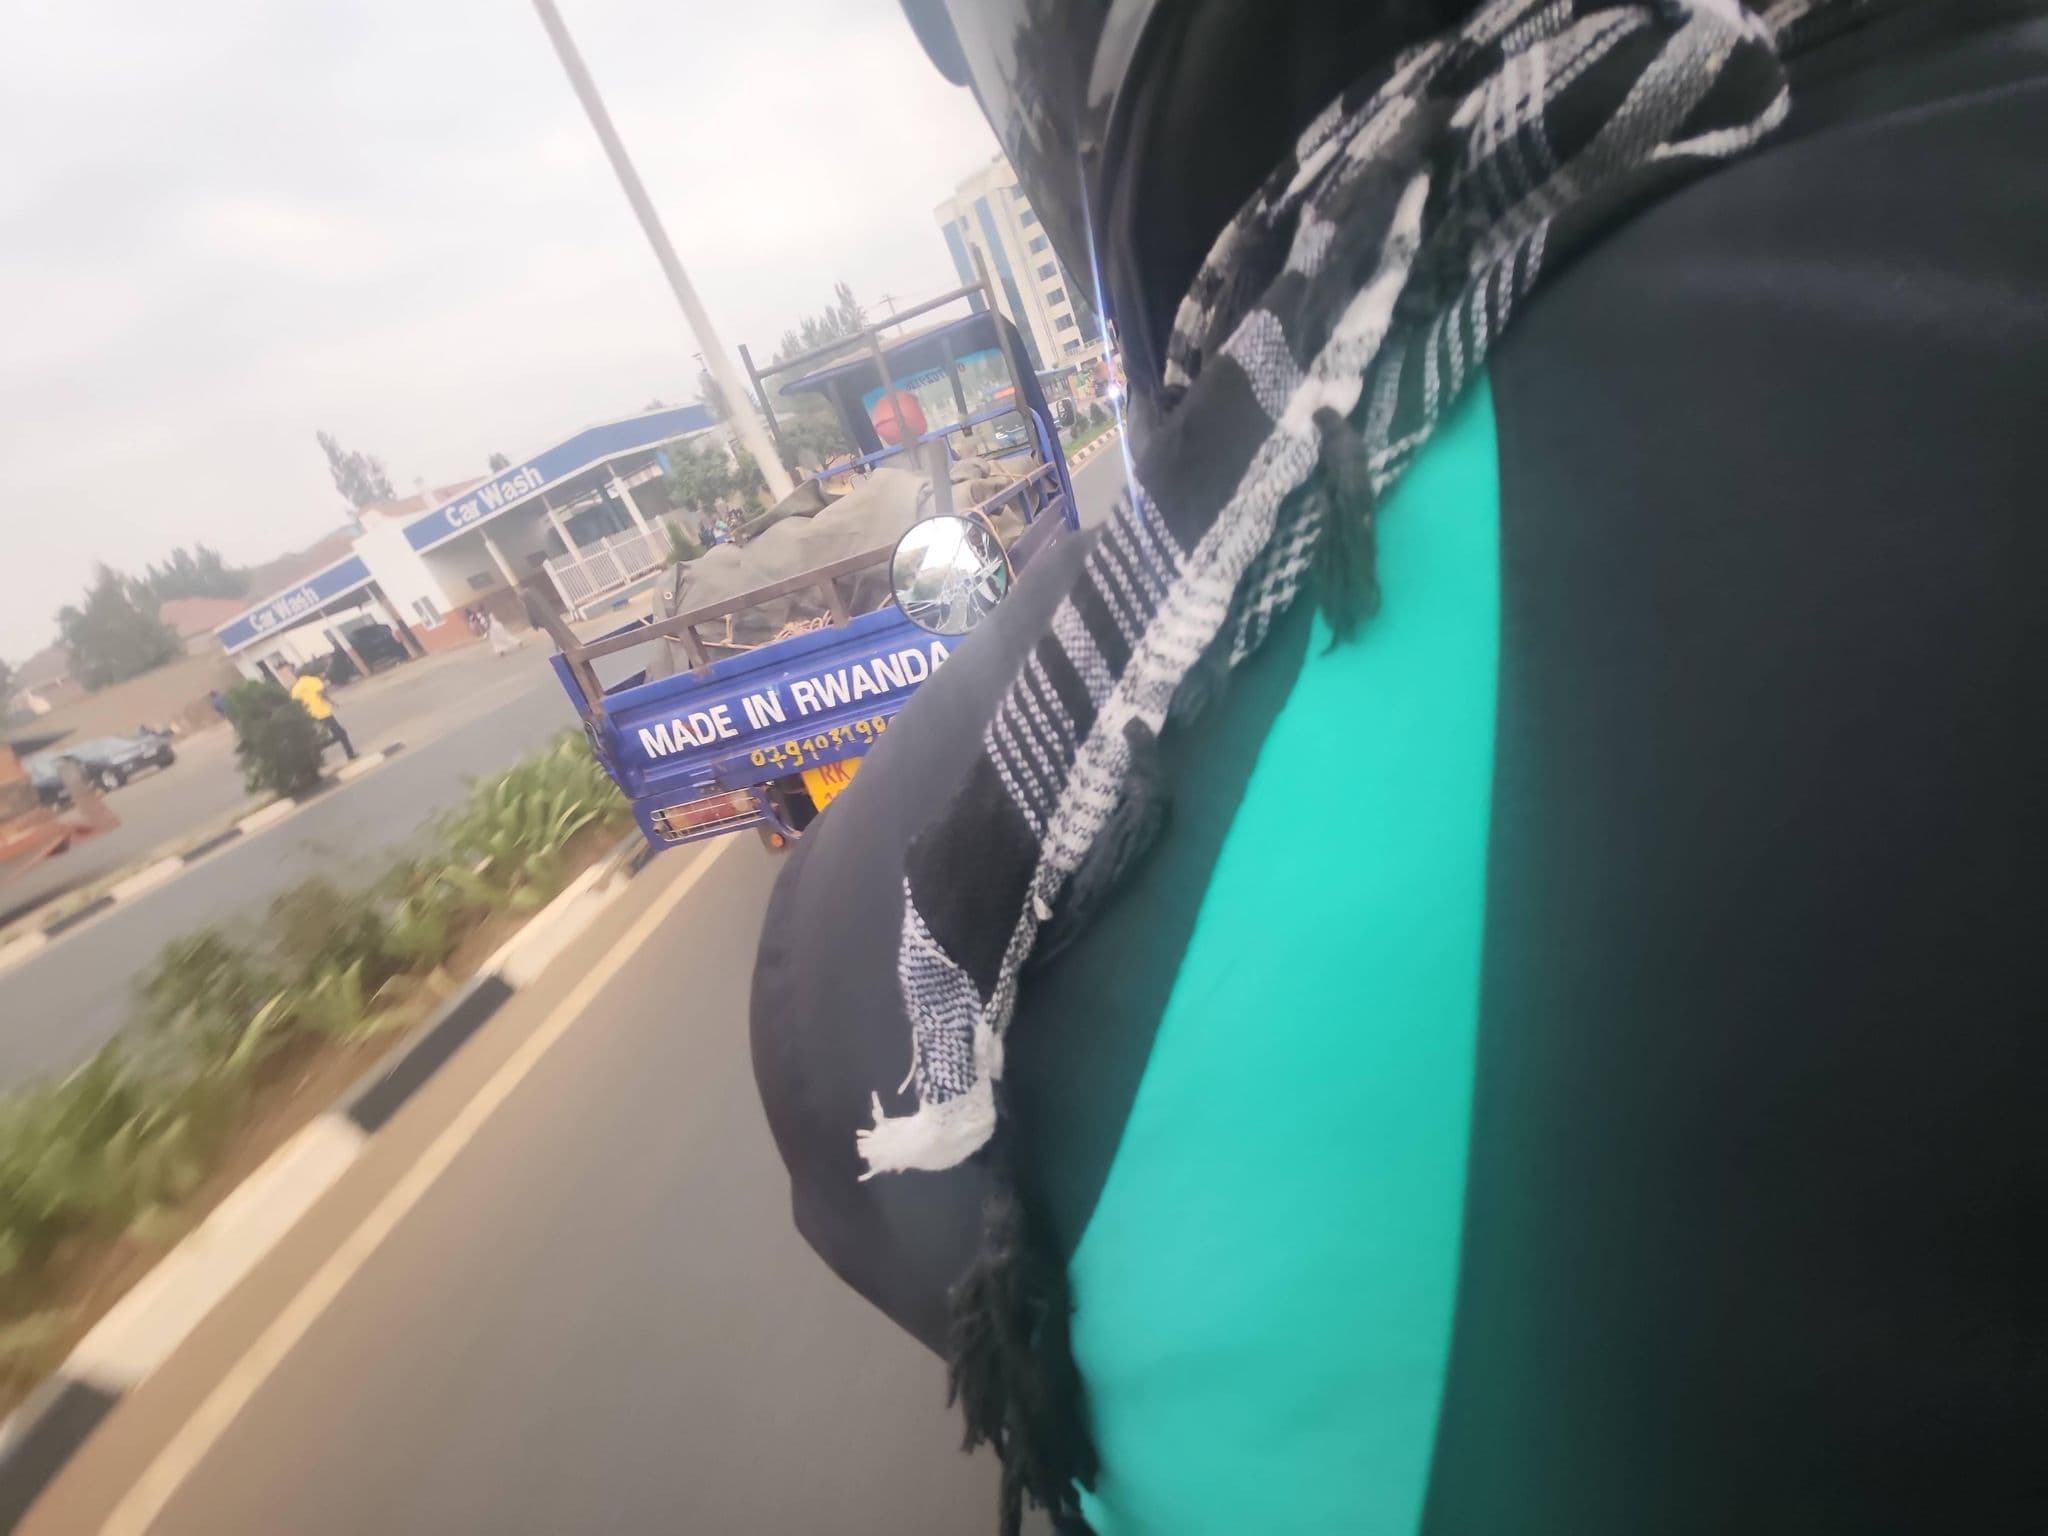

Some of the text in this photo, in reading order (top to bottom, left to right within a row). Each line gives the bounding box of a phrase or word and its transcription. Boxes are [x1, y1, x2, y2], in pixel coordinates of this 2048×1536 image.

[445, 465, 546, 529] Car Wash
[638, 640, 952, 759] MADE IN RWANDA
